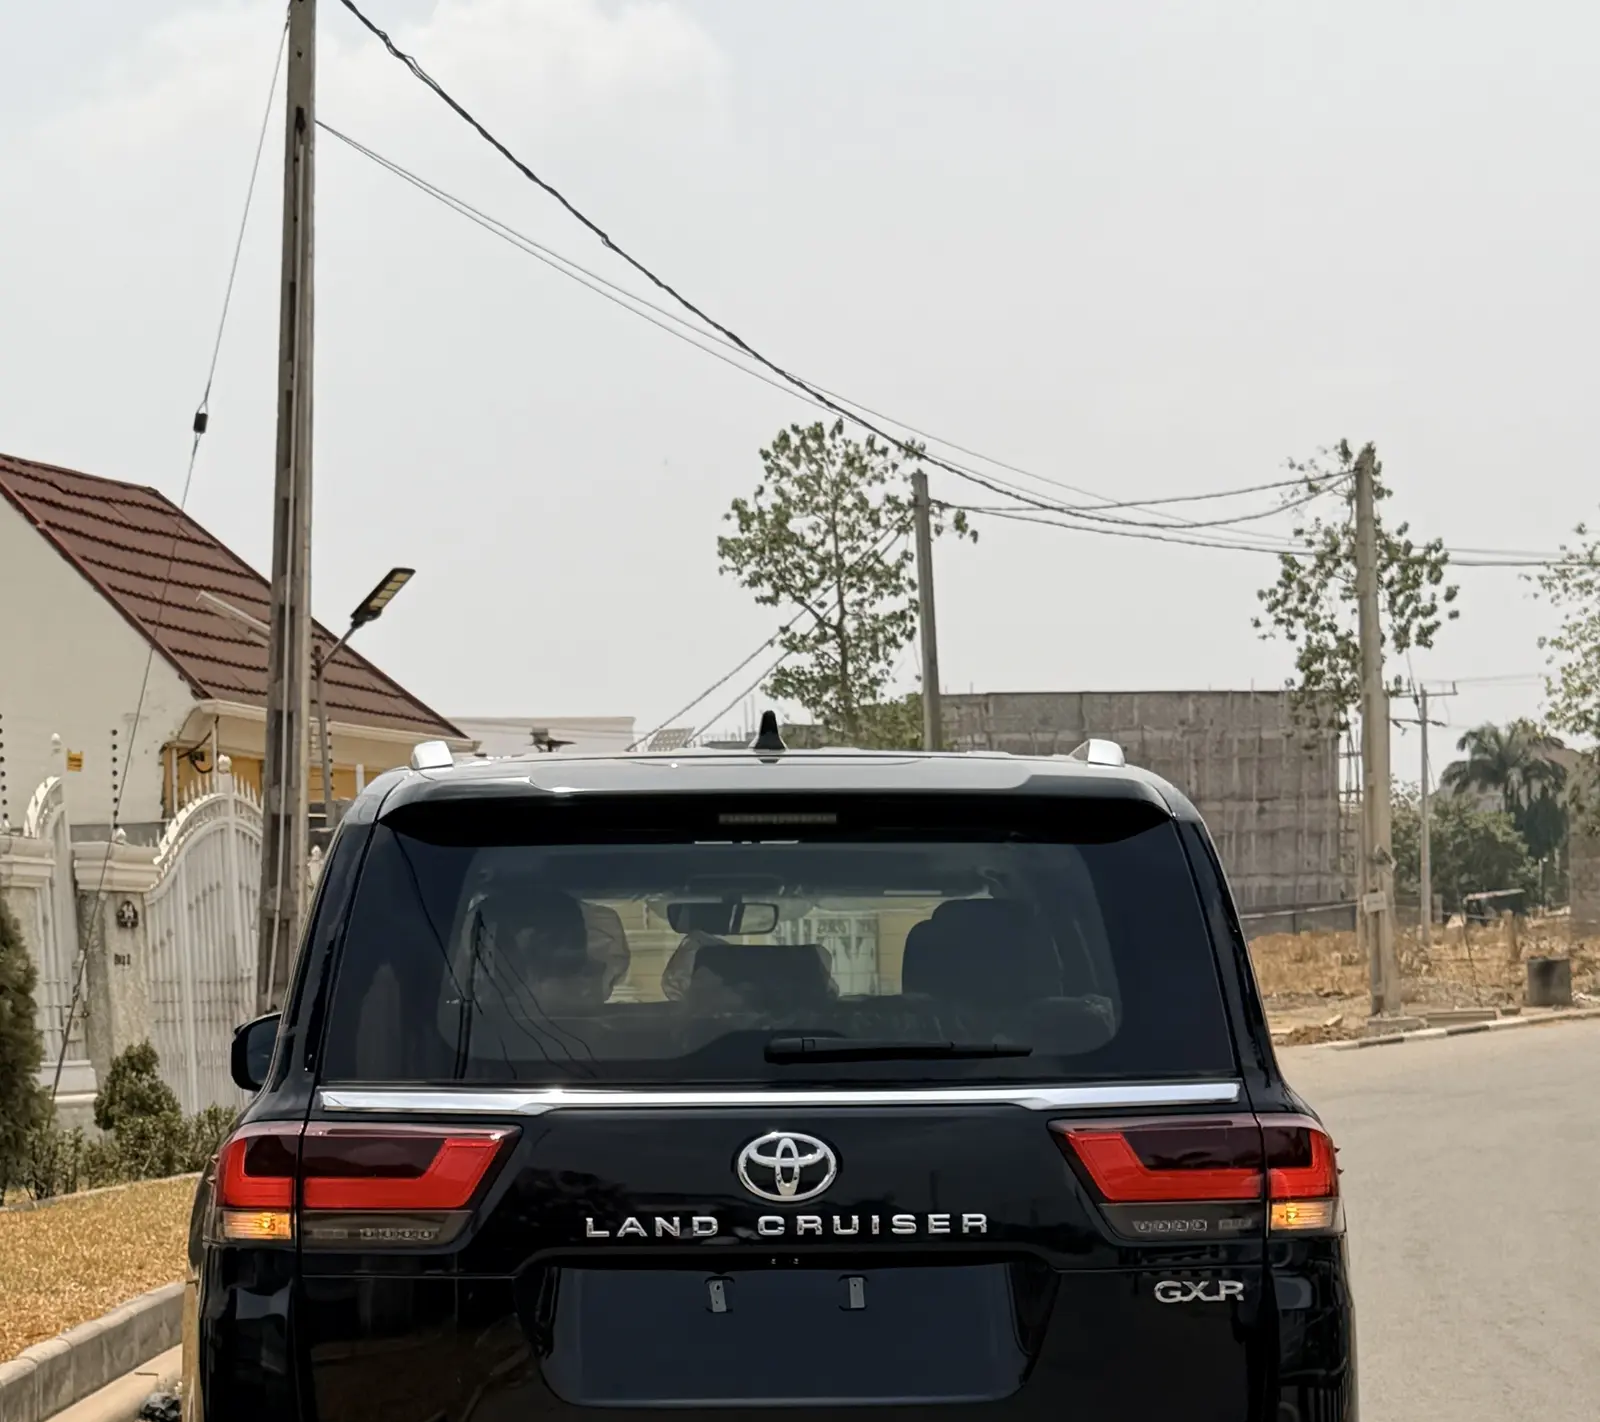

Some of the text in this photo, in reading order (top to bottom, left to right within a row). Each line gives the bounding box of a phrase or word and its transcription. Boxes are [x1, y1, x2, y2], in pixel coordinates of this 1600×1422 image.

[586, 1213, 988, 1238] LAND CRUISER
[1154, 1280, 1244, 1303] GXR
